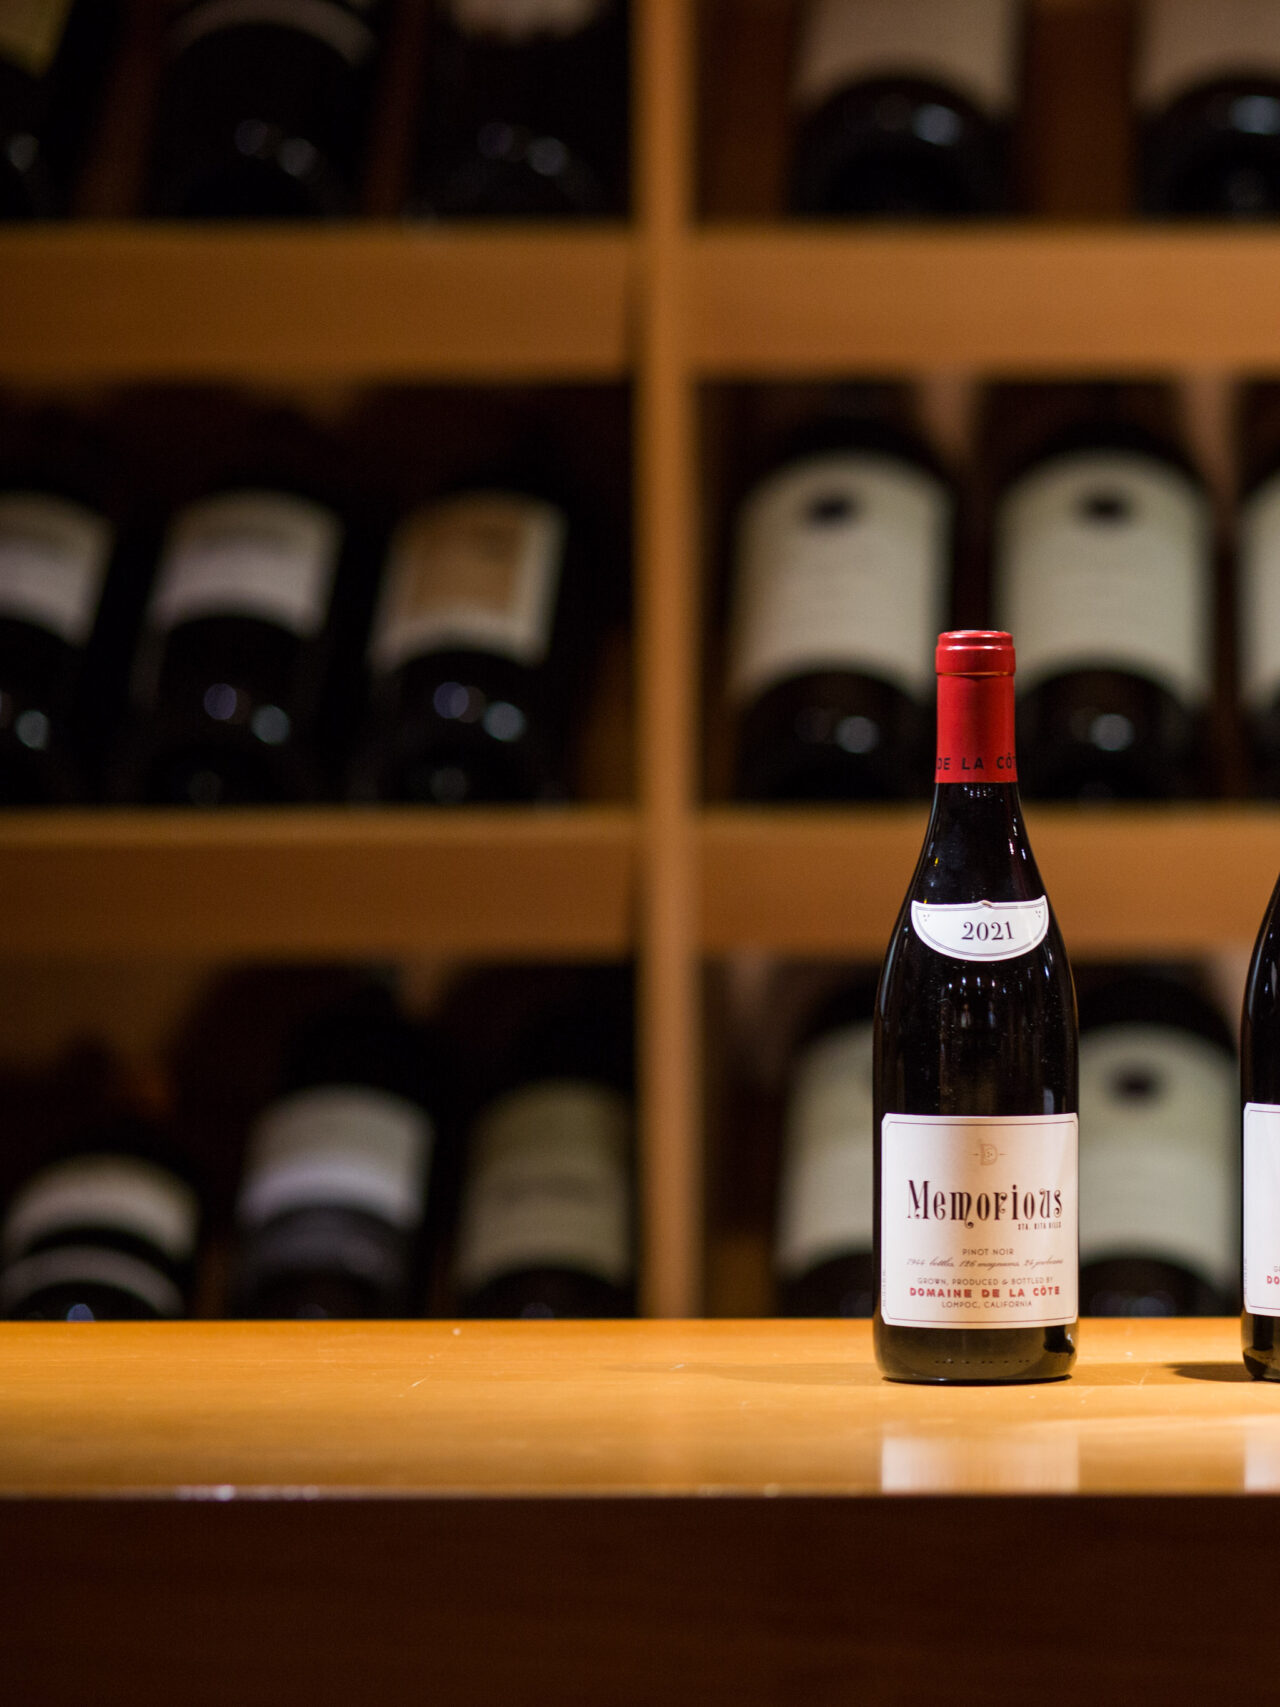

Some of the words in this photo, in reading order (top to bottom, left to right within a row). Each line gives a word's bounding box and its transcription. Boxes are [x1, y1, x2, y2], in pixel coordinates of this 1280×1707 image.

[962, 757, 984, 770] LA
[961, 921, 1015, 941] 2021
[907, 1179, 1063, 1229] Memorious
[962, 1248, 988, 1256] PINOT
[992, 1248, 1014, 1256] NOIR
[918, 1277, 949, 1286] GROWN,
[952, 1278, 998, 1286] PRODUCED
[1011, 1277, 1044, 1285] BOTTLED
[910, 1287, 972, 1298] DOMAINE
[981, 1289, 1000, 1298] DE
[1009, 1288, 1025, 1298] LA
[1033, 1285, 1060, 1296] CÔTE
[942, 1301, 981, 1309] LOMPOC,
[984, 1301, 1032, 1309] CALIFORNIA
